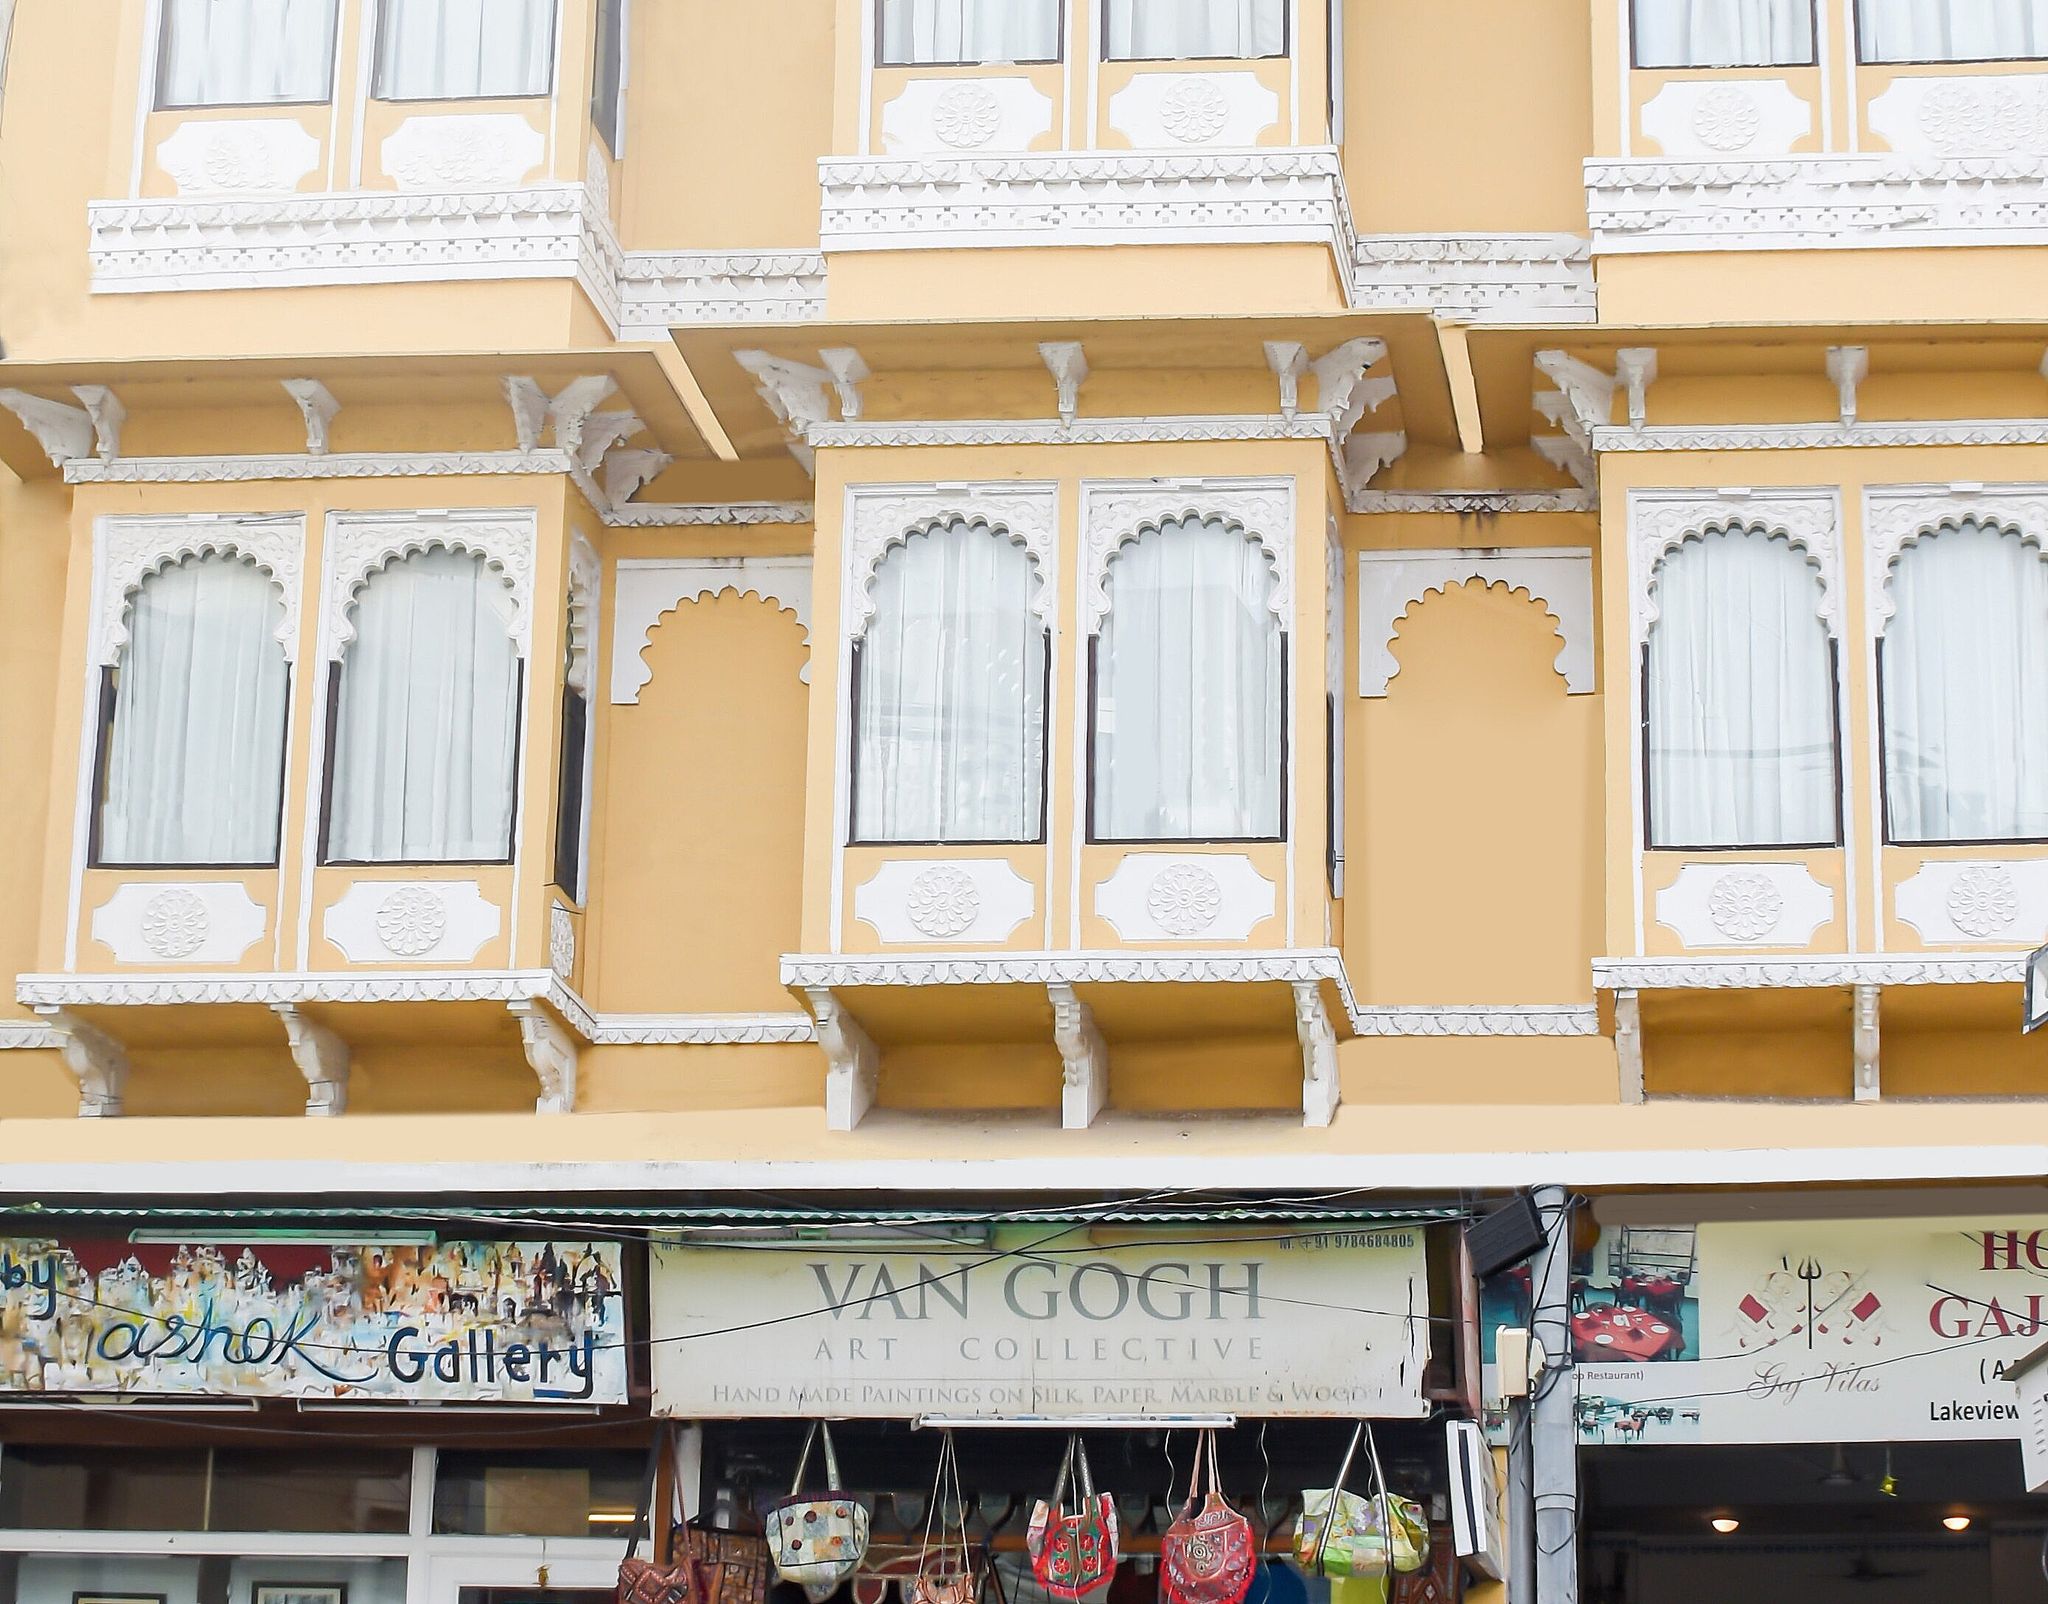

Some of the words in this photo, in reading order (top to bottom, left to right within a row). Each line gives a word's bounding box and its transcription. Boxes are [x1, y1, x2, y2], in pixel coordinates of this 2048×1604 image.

[1335, 1233, 1414, 1249] 9784684805
[2, 1249, 57, 1321] by
[806, 1262, 975, 1320] VAN
[1003, 1261, 1266, 1321] GOGH
[1929, 1295, 2044, 1338] GAJ
[388, 1326, 594, 1400] Gallery
[813, 1337, 898, 1361] ART
[959, 1337, 1266, 1361] COLLECTIVE
[713, 1384, 780, 1401] HAND
[788, 1384, 850, 1402] MADE
[862, 1384, 982, 1404] PAINTINGS
[989, 1386, 1023, 1404] ON
[1171, 1385, 1259, 1402] MARBLE
[1266, 1386, 1284, 1402] &
[1747, 1361, 1804, 1406] Gaj
